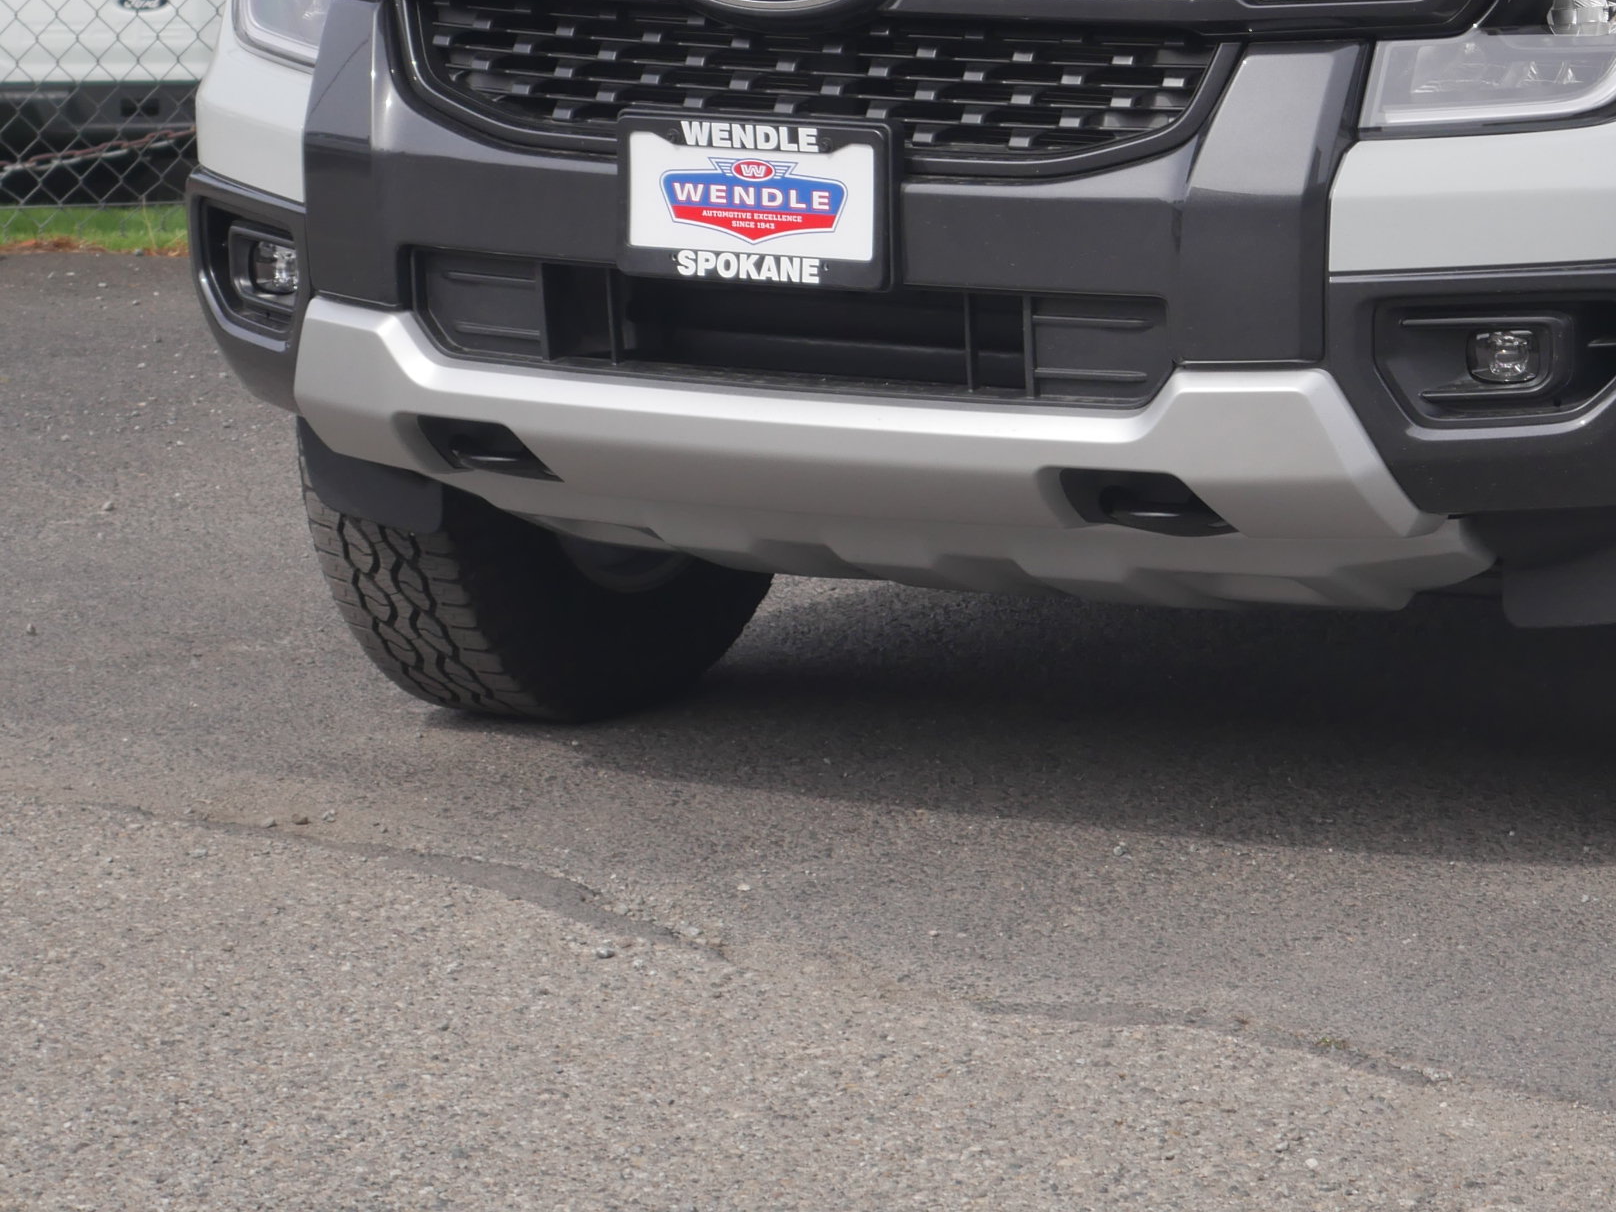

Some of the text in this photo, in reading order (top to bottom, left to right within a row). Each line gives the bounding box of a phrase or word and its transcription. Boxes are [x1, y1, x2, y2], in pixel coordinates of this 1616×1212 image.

[680, 120, 820, 152] WENDLE
[673, 182, 830, 210] WENDLE
[702, 209, 803, 223] AUTOMOTIVE EXCELLENCE
[731, 220, 755, 229] SINCE
[677, 249, 820, 284] SPOKANE
